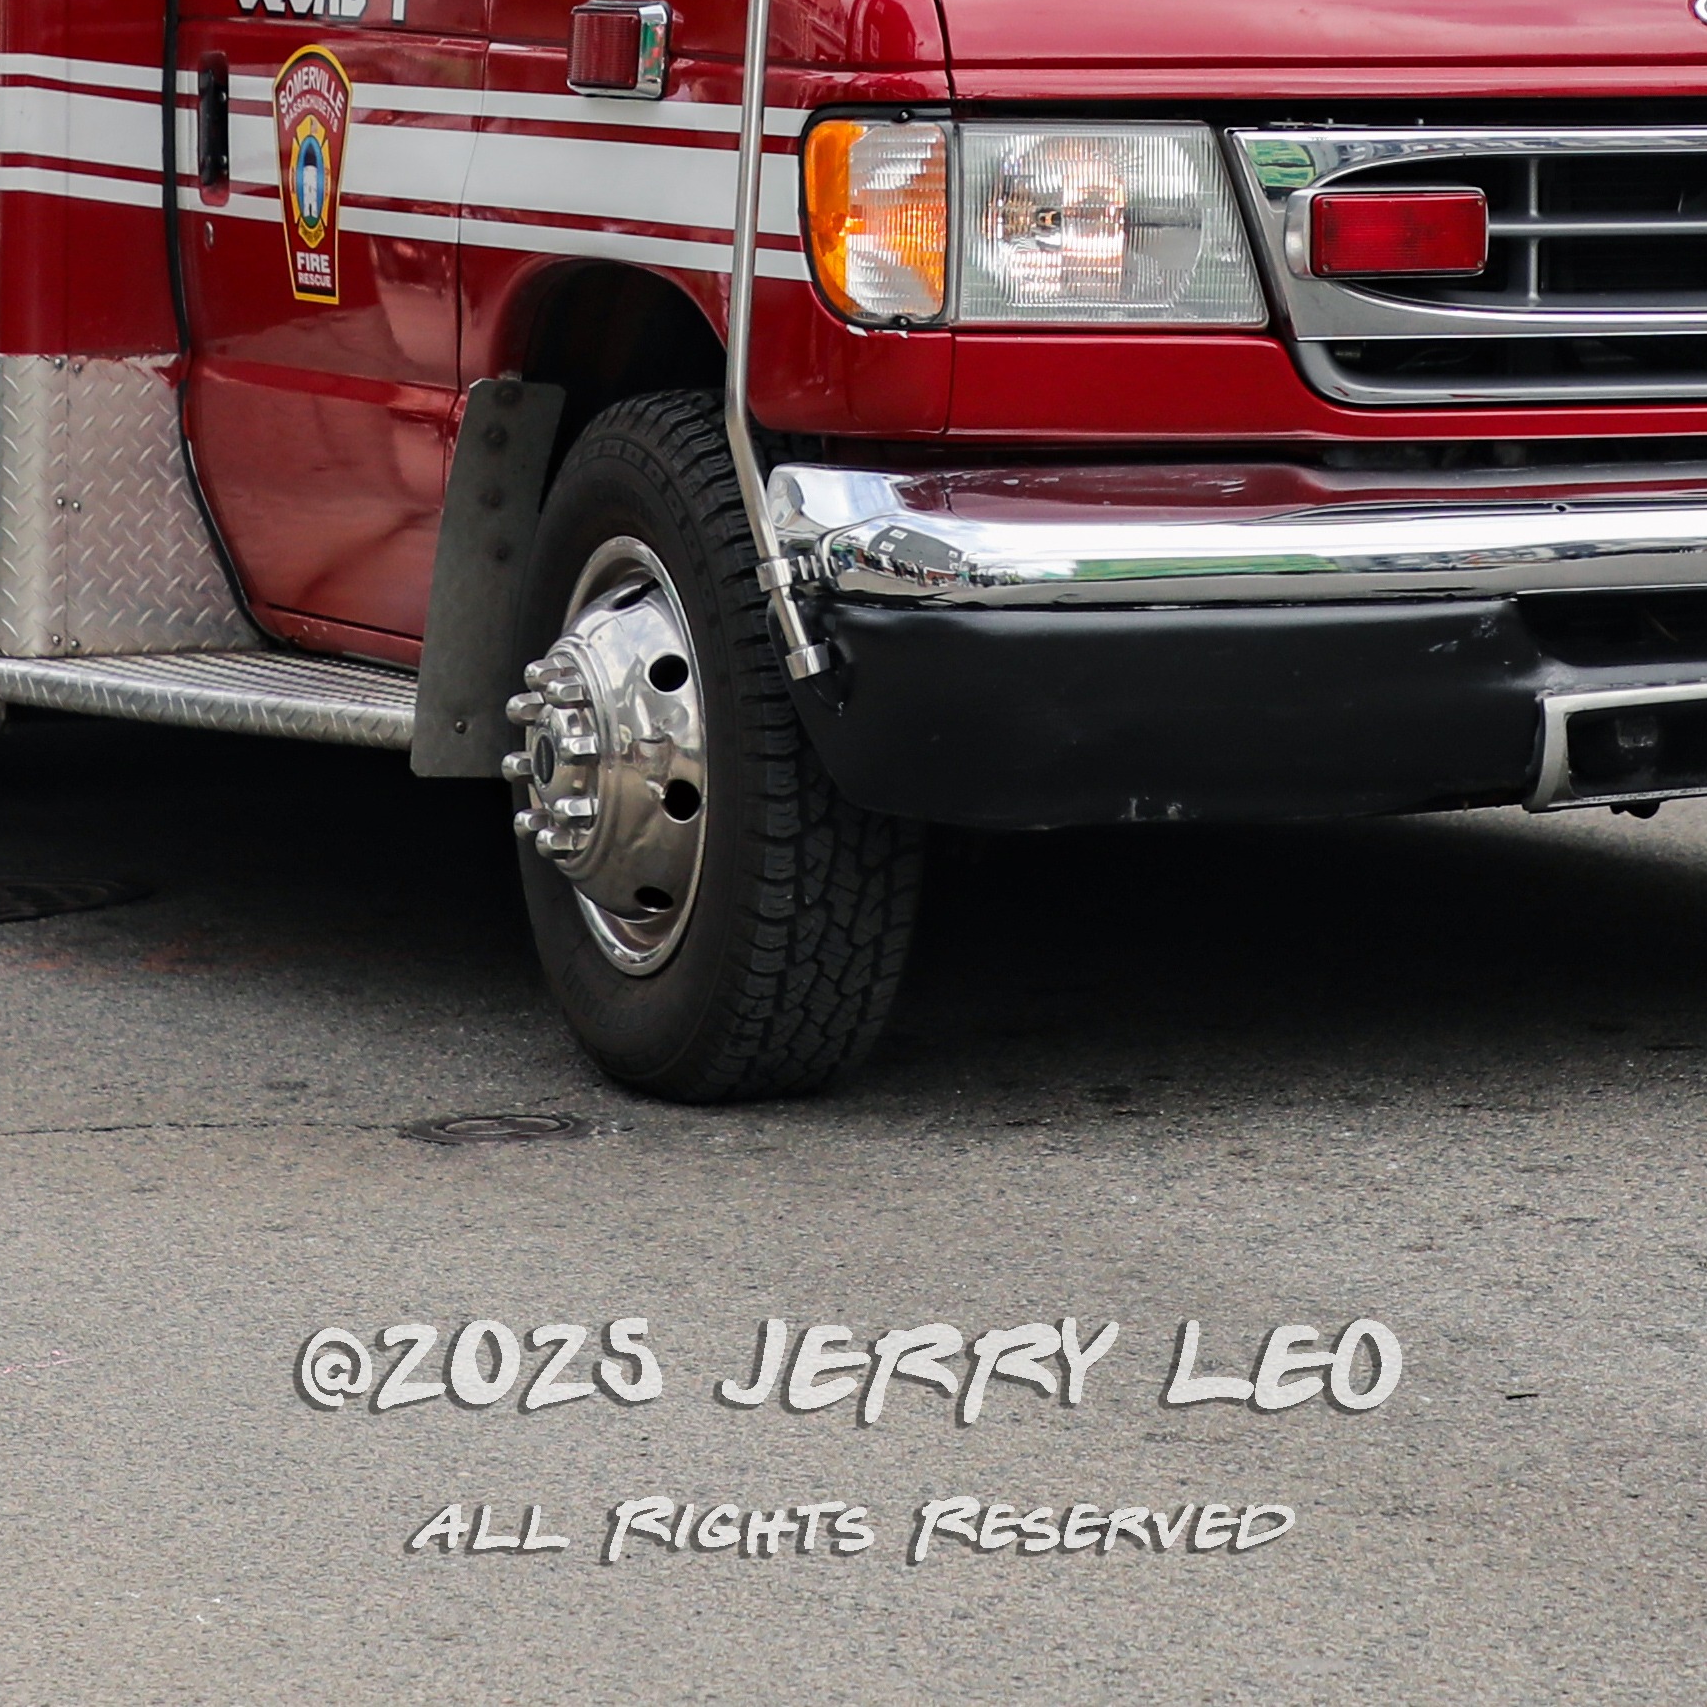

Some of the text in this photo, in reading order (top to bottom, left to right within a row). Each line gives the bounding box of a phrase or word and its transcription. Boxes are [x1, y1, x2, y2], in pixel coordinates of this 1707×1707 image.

[279, 66, 345, 117] SOMERVILLE
[283, 93, 338, 133] MASSACHUSETTS
[296, 250, 331, 274] FIRE
[297, 271, 332, 289] RESCUE
